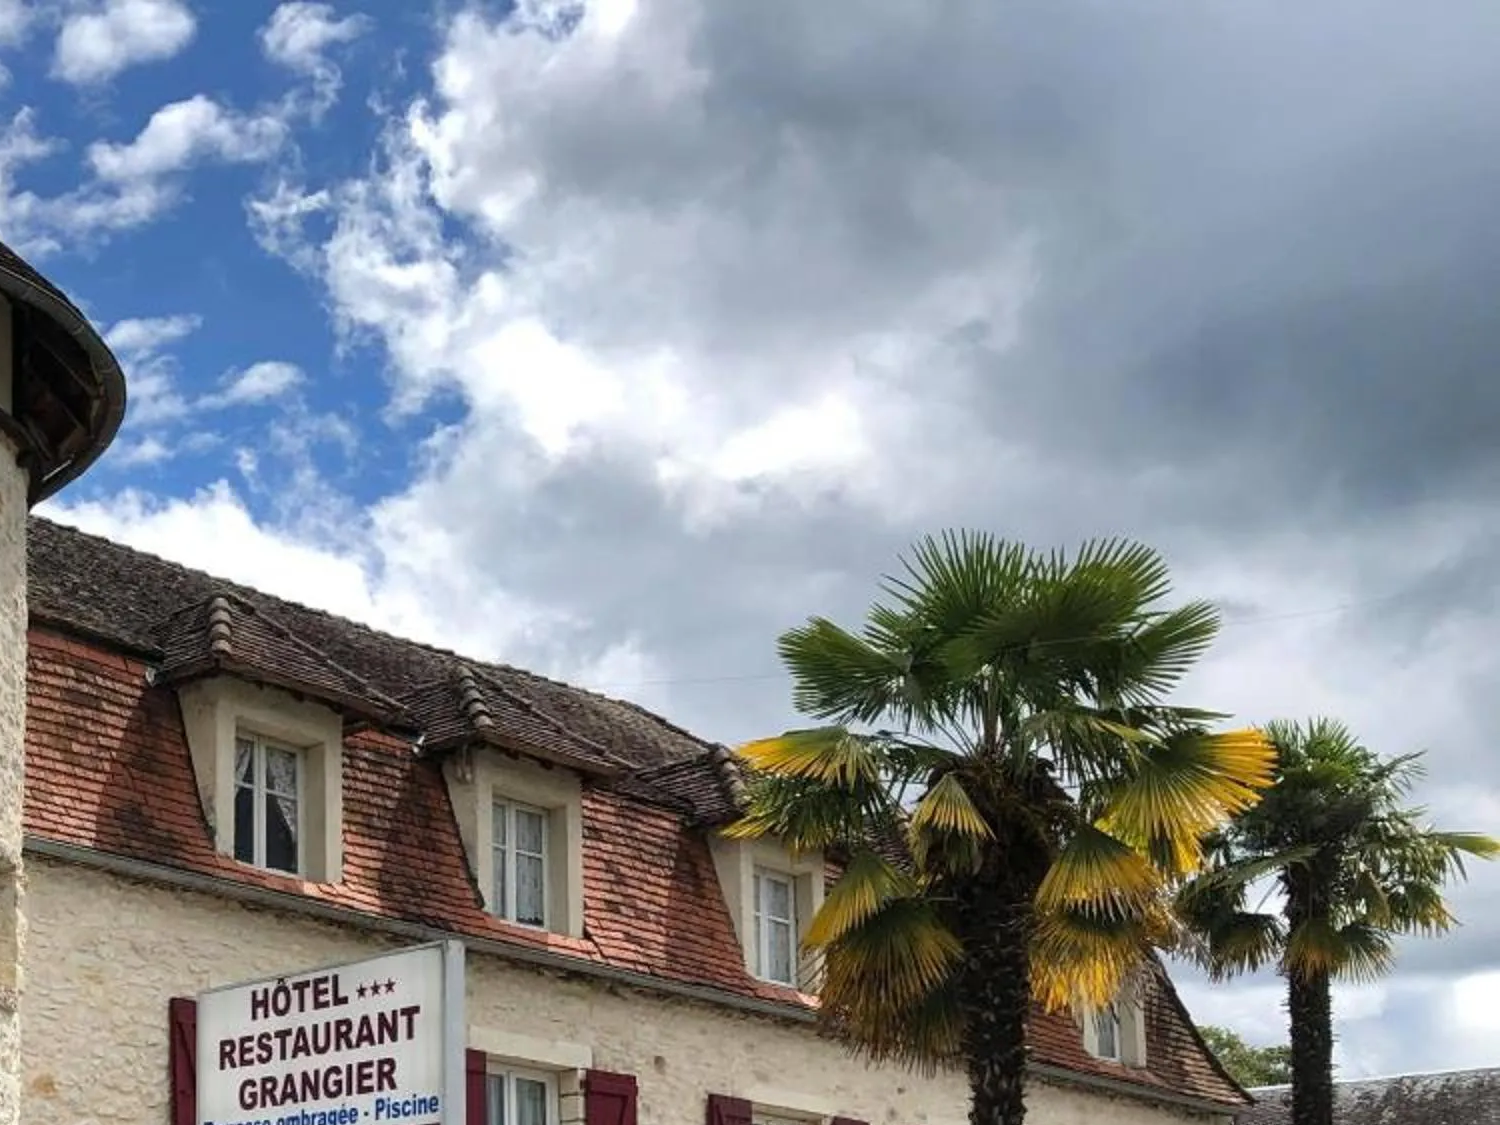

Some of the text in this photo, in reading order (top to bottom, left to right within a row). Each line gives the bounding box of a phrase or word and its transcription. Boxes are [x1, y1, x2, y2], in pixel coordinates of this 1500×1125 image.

[251, 974, 349, 1021] HÔTEL
[219, 1006, 421, 1070] RESTAURANT
[238, 1057, 398, 1110] GRANGIER
[374, 1093, 440, 1120] Piscine
